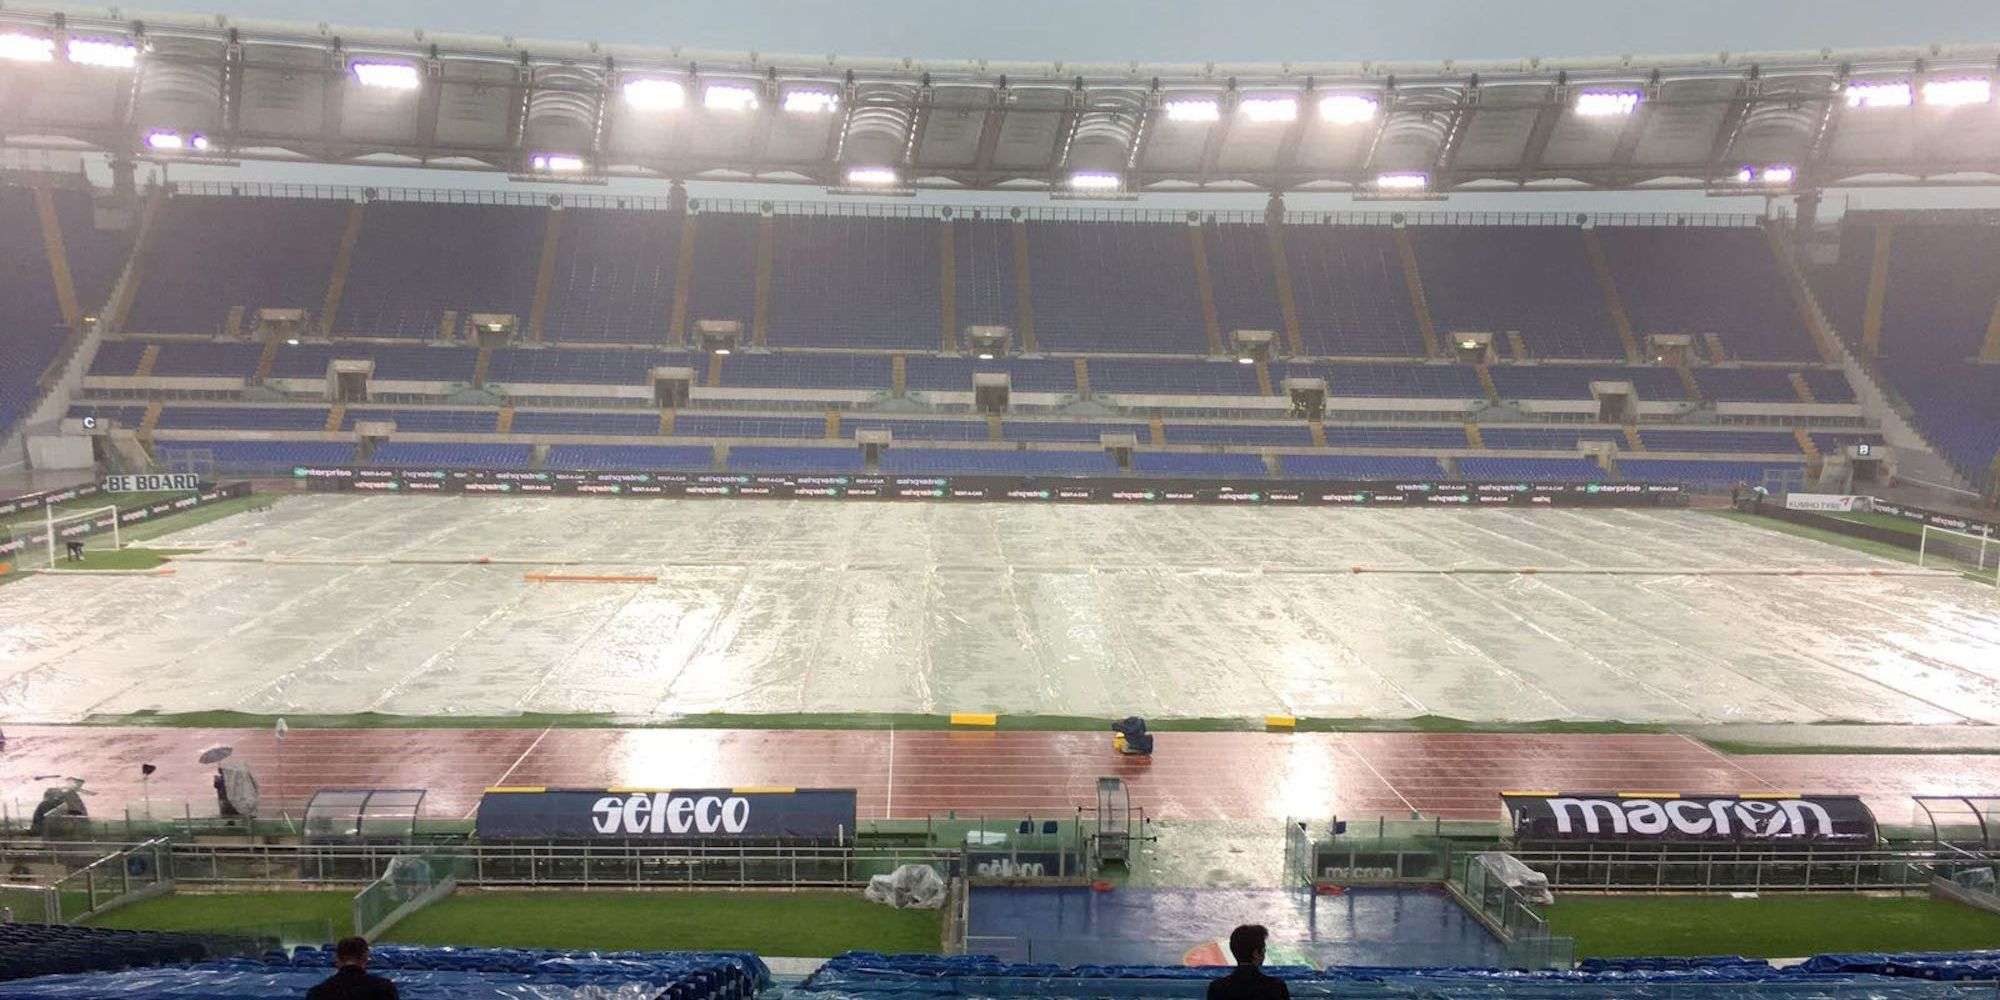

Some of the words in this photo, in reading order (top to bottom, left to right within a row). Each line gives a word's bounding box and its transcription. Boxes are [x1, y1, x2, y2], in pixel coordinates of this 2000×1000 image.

[84, 417, 95, 428] C
[109, 476, 131, 491] BE
[137, 475, 198, 490] BOARD
[1546, 798, 1833, 835] macron
